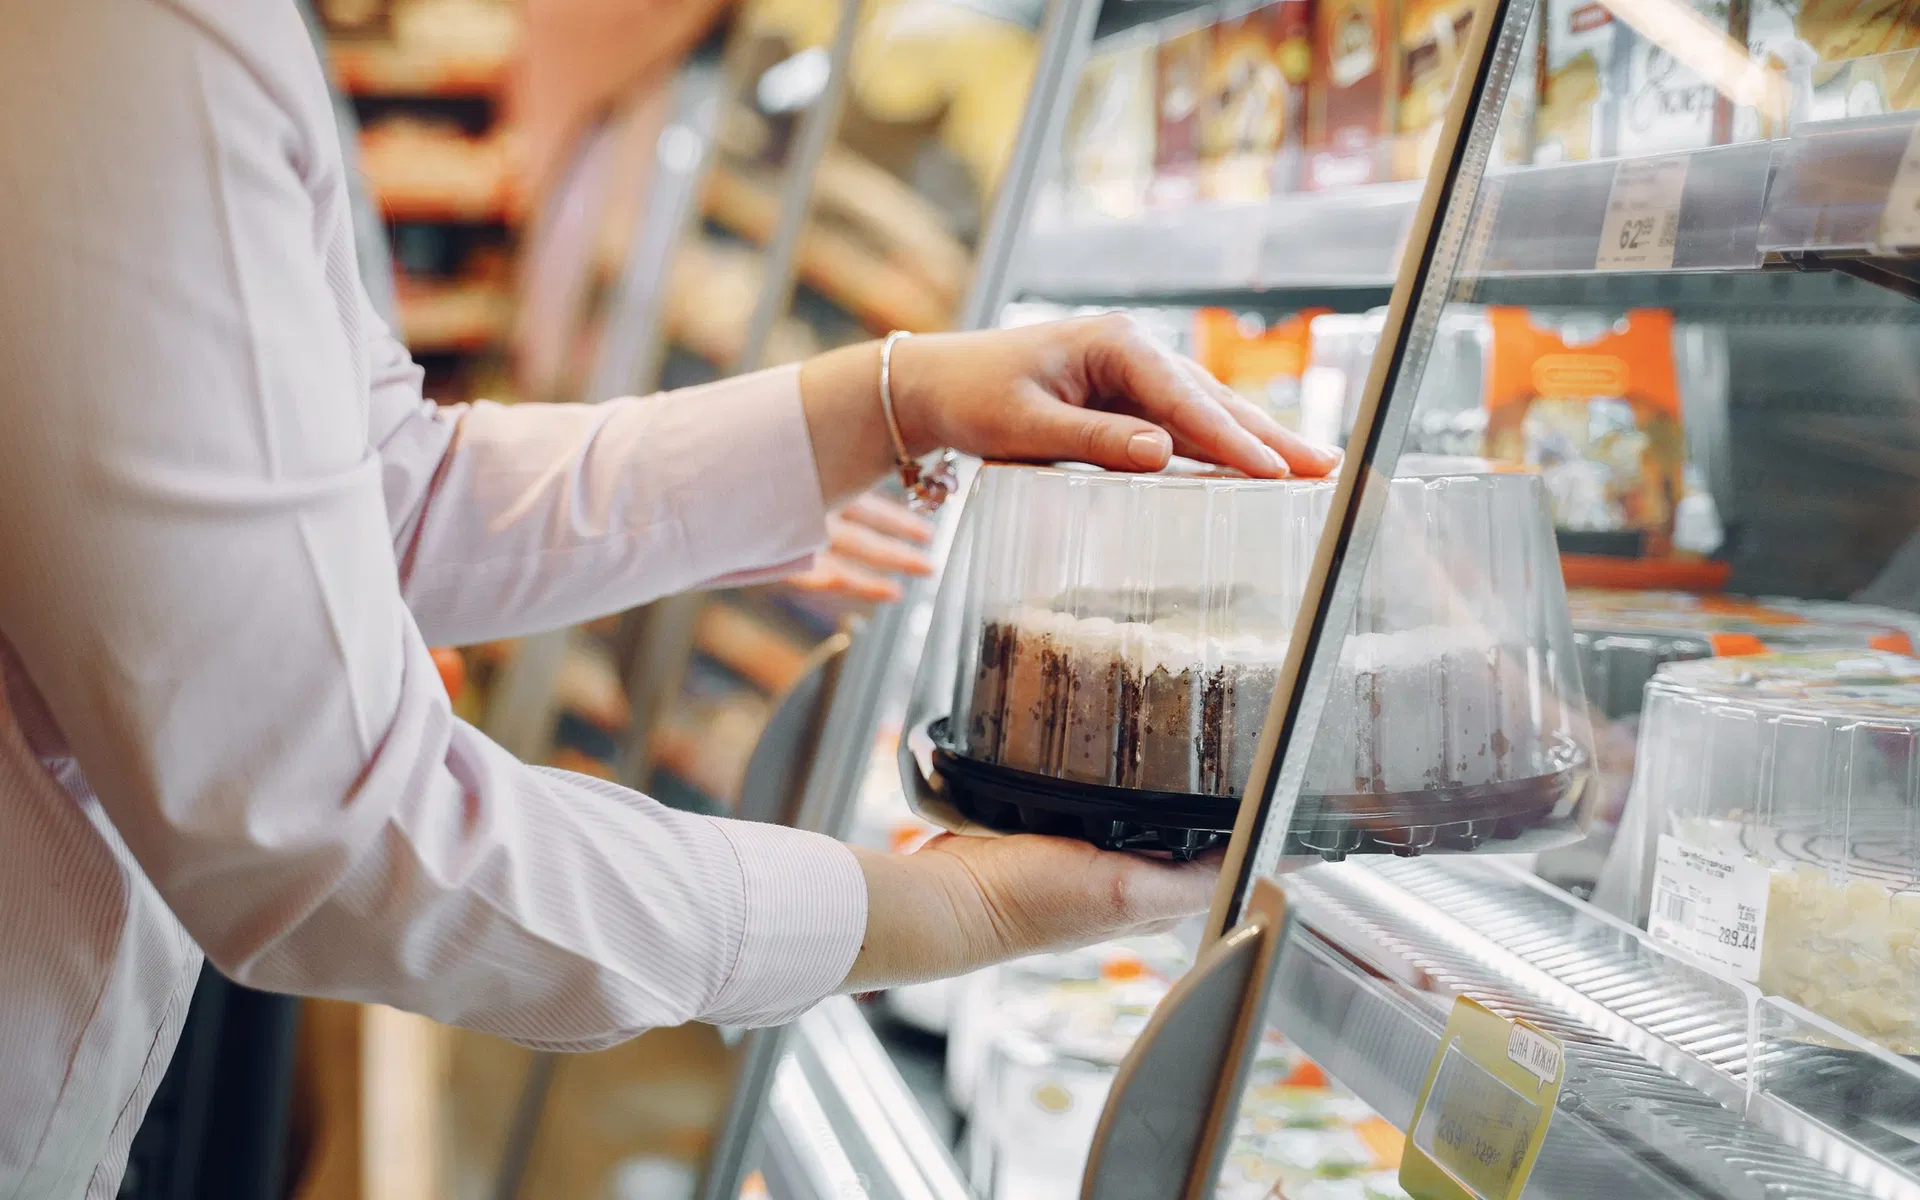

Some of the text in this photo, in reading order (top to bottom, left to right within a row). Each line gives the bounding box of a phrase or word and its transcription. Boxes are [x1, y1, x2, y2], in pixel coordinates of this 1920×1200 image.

[1620, 219, 1643, 248] 62
[1718, 926, 1757, 952] 289.44
[1508, 1029, 1558, 1076] ЦІНА ТИЖНЯ
